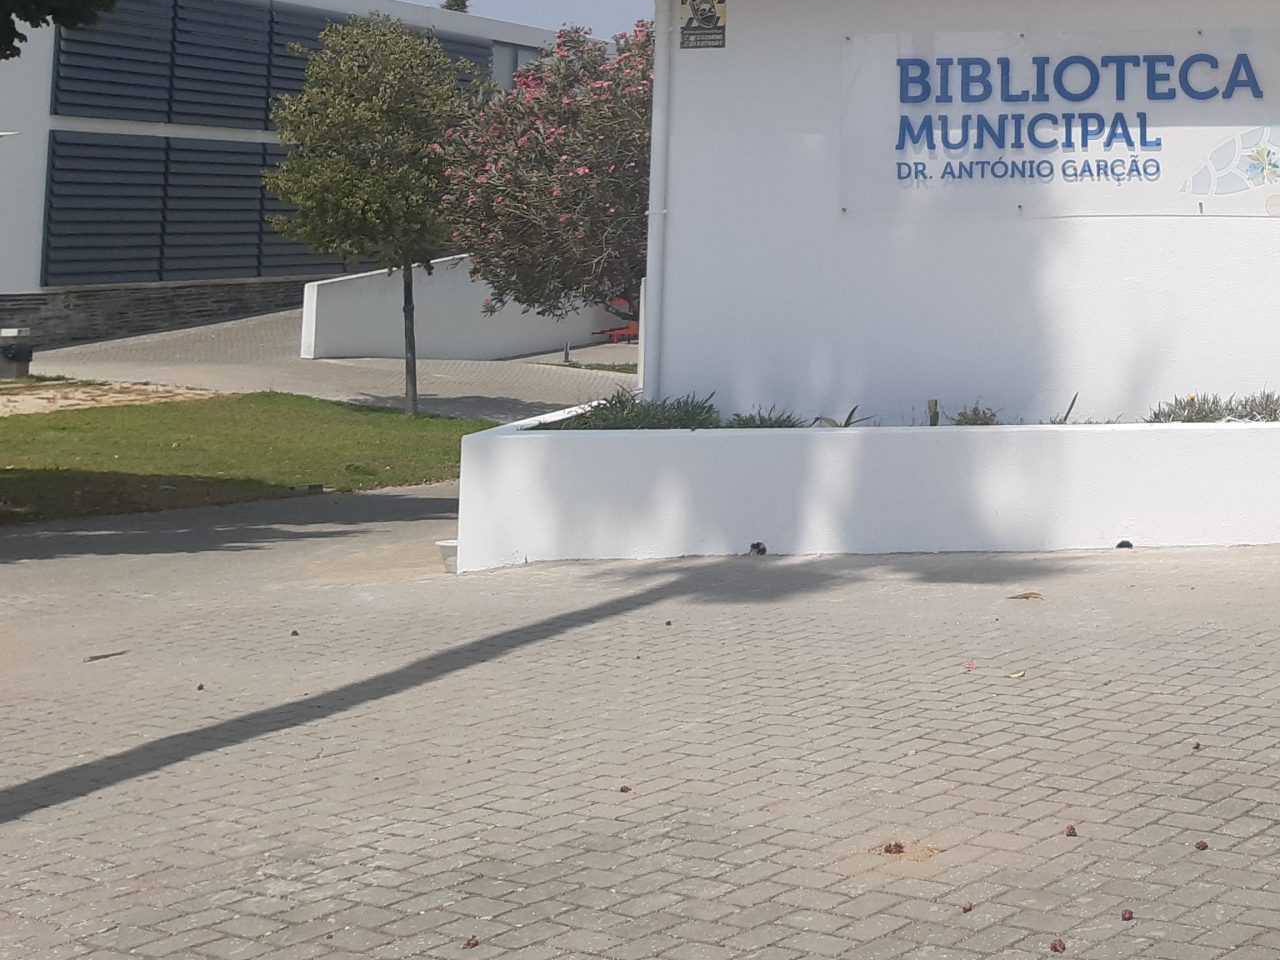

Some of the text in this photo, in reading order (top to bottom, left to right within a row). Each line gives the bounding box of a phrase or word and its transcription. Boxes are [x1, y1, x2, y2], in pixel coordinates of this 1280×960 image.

[896, 53, 1263, 103] BIBLIOTECA
[895, 112, 1162, 151] MUNICIPAL
[896, 155, 1161, 187] DR. ANTÓNIO GARÇÃO
